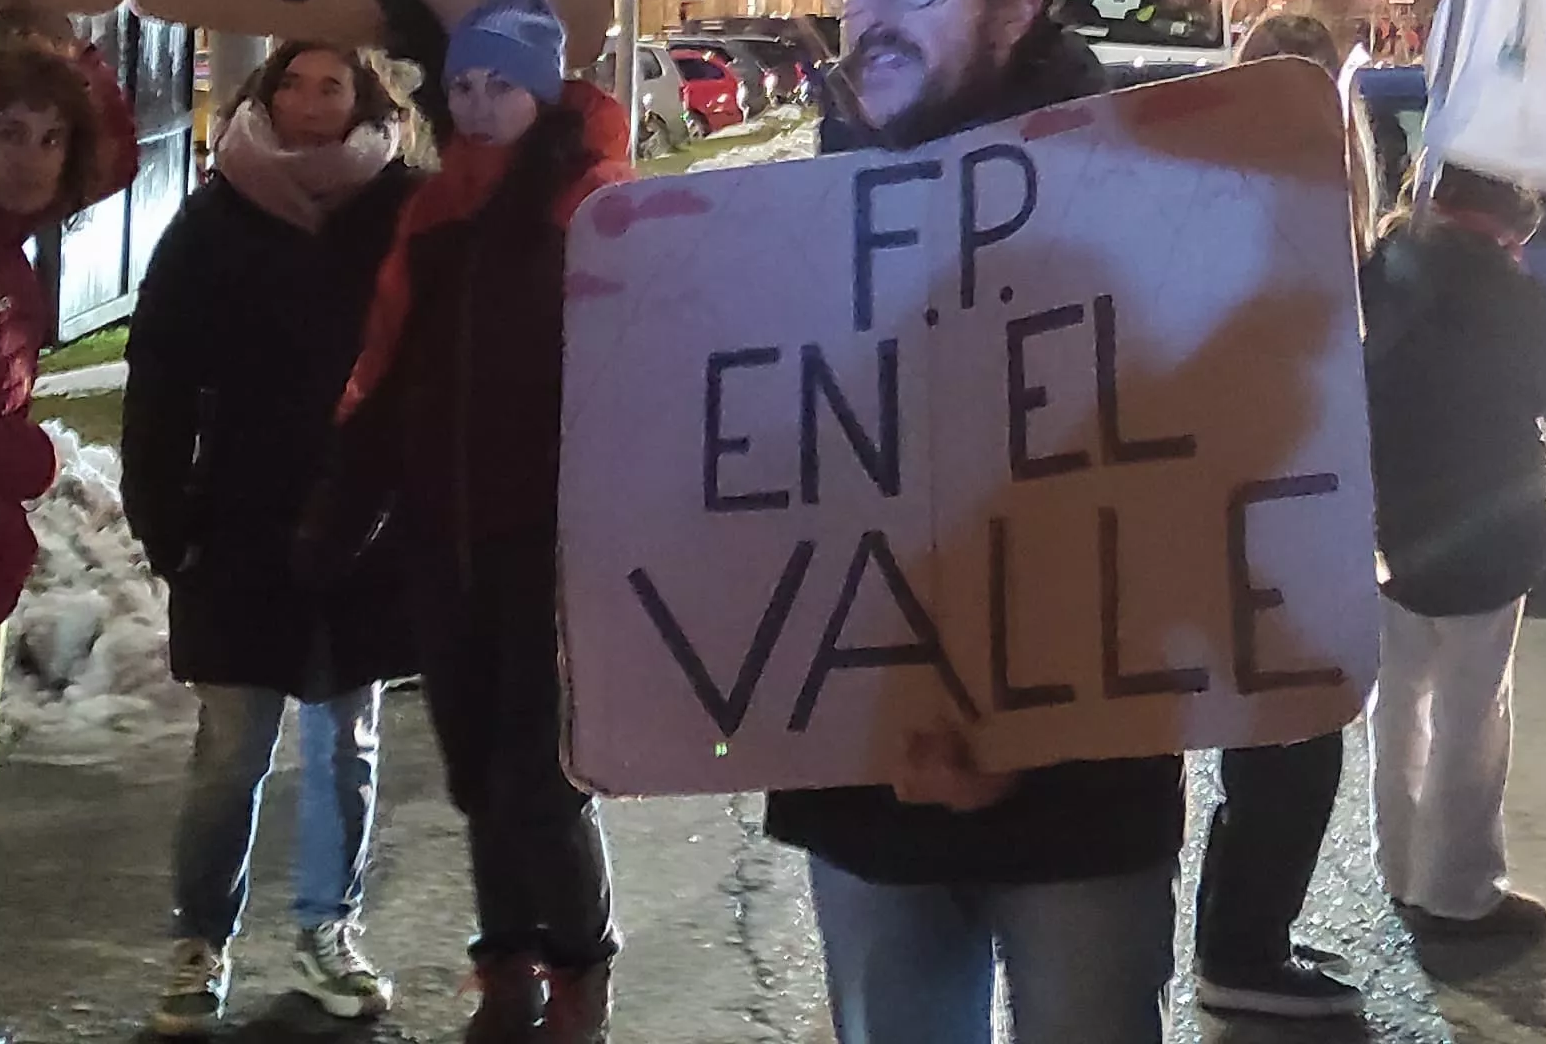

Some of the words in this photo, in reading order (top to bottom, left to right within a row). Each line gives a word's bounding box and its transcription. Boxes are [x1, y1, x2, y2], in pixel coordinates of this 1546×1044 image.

[853, 143, 1039, 332] F.P.
[702, 338, 901, 513] EN
[1006, 295, 1196, 483] EL
[628, 472, 1345, 739] VALLE
